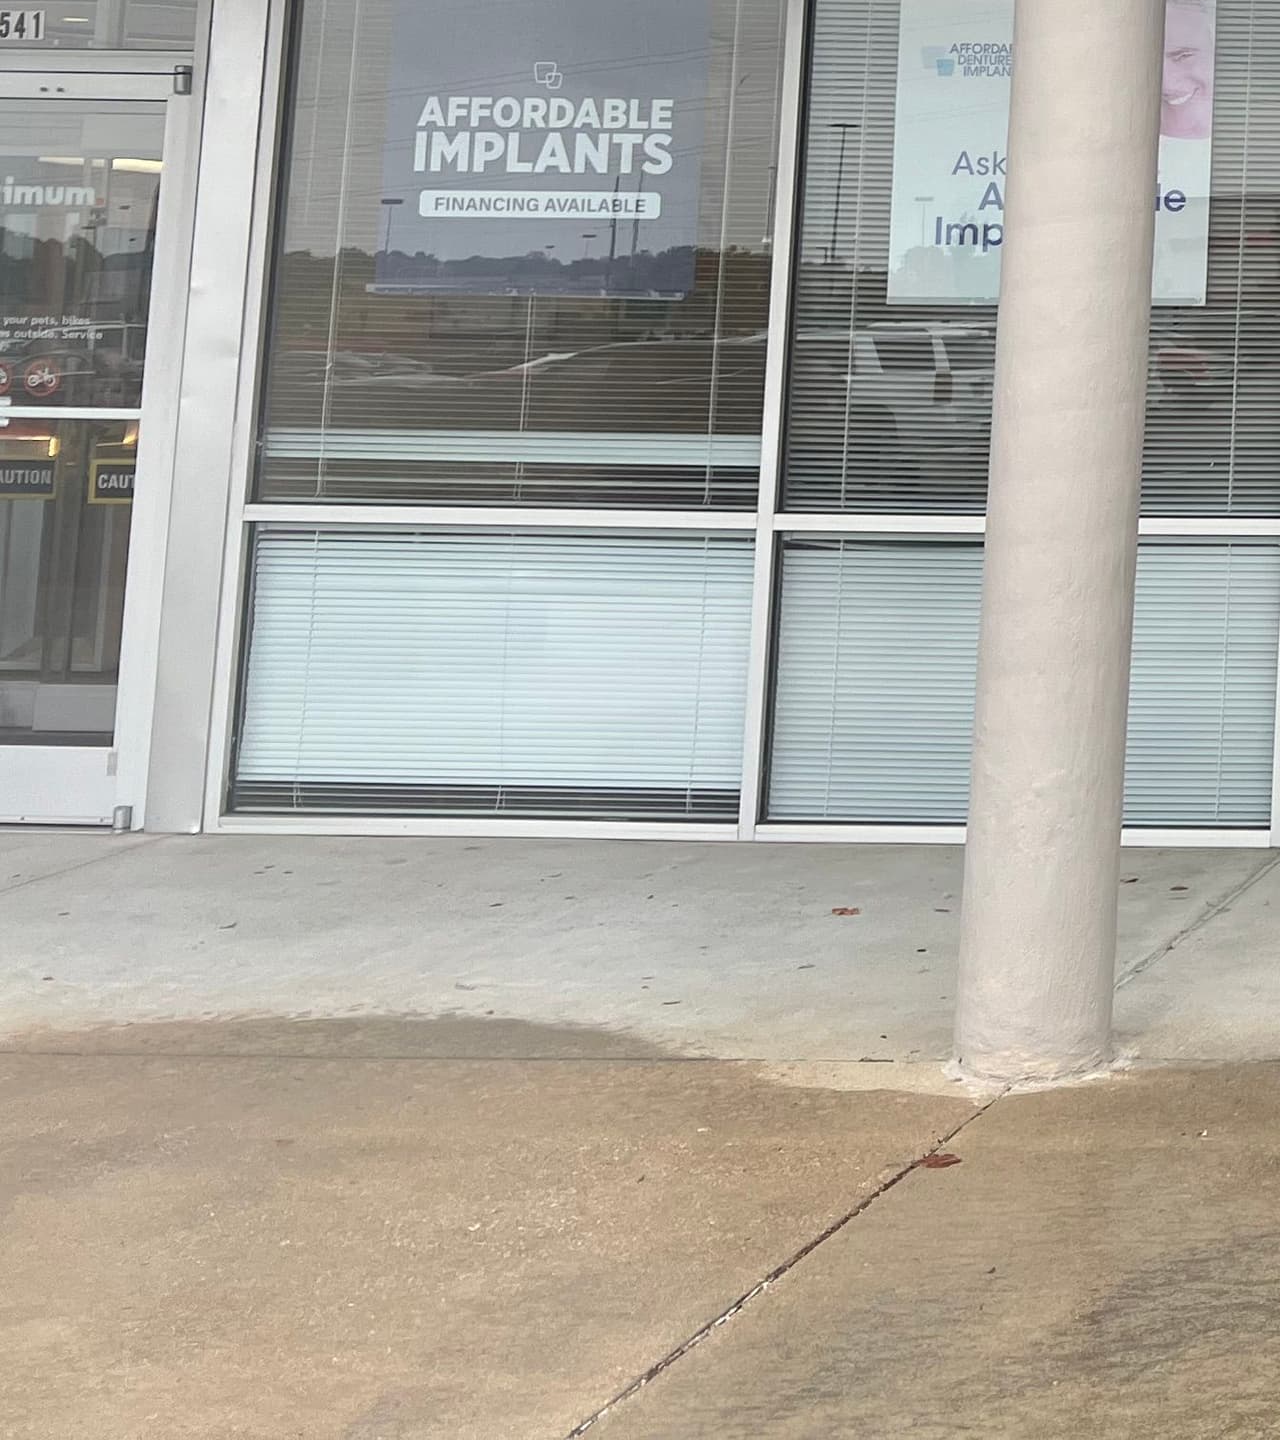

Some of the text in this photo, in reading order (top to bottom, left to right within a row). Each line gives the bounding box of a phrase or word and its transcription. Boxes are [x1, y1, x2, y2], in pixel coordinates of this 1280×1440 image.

[958, 54, 1013, 66] DENTURE
[963, 66, 1012, 77] IMPLAN
[416, 95, 675, 130] AFFORDABLE
[413, 130, 673, 175] IMPLANTS
[951, 150, 1007, 176] Ask
[434, 196, 647, 214] FINANCING AVAILABLE
[97, 474, 136, 489] CAUT
